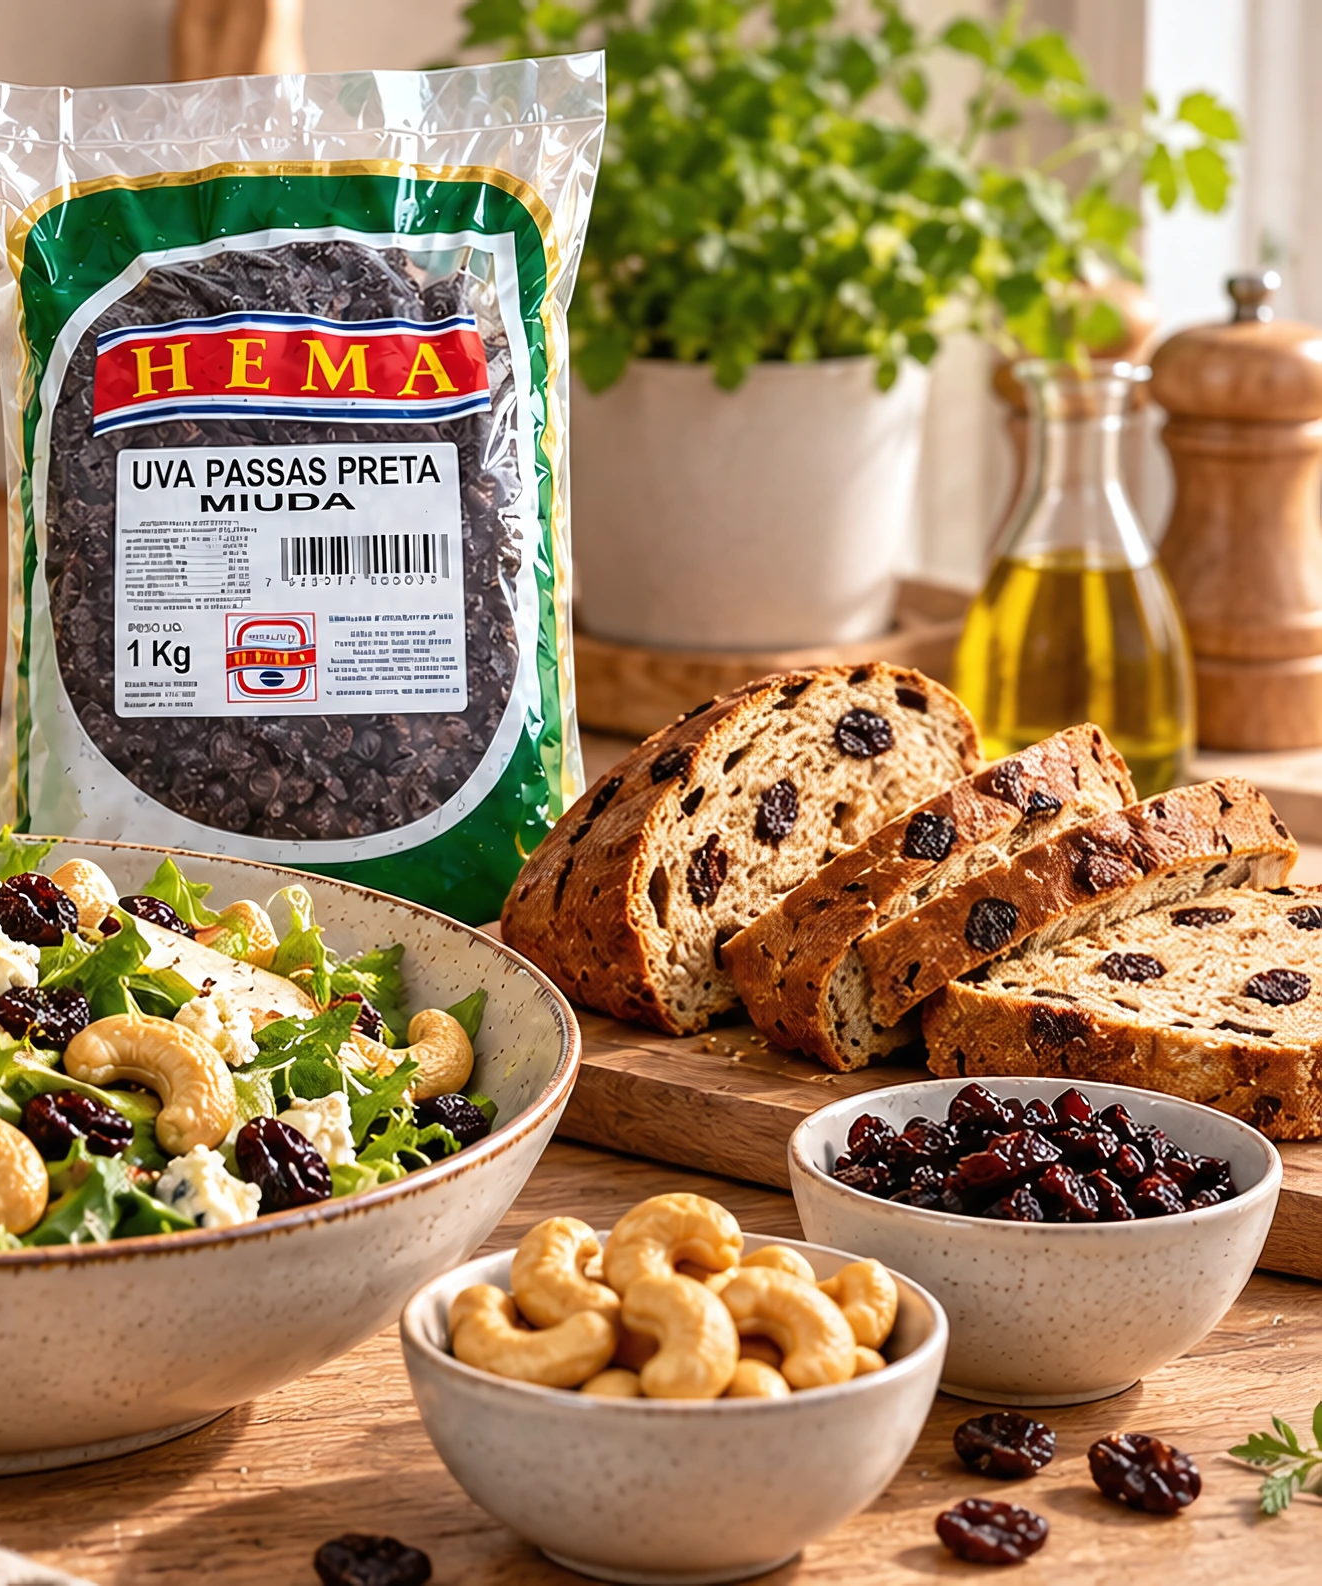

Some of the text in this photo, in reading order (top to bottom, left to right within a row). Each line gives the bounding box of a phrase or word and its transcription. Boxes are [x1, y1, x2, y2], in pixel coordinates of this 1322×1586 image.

[130, 338, 459, 398] HEMA
[132, 454, 441, 489] UVA PASSAS PRETA
[200, 492, 356, 513] MIUDA
[126, 639, 191, 675] 1 Kg
